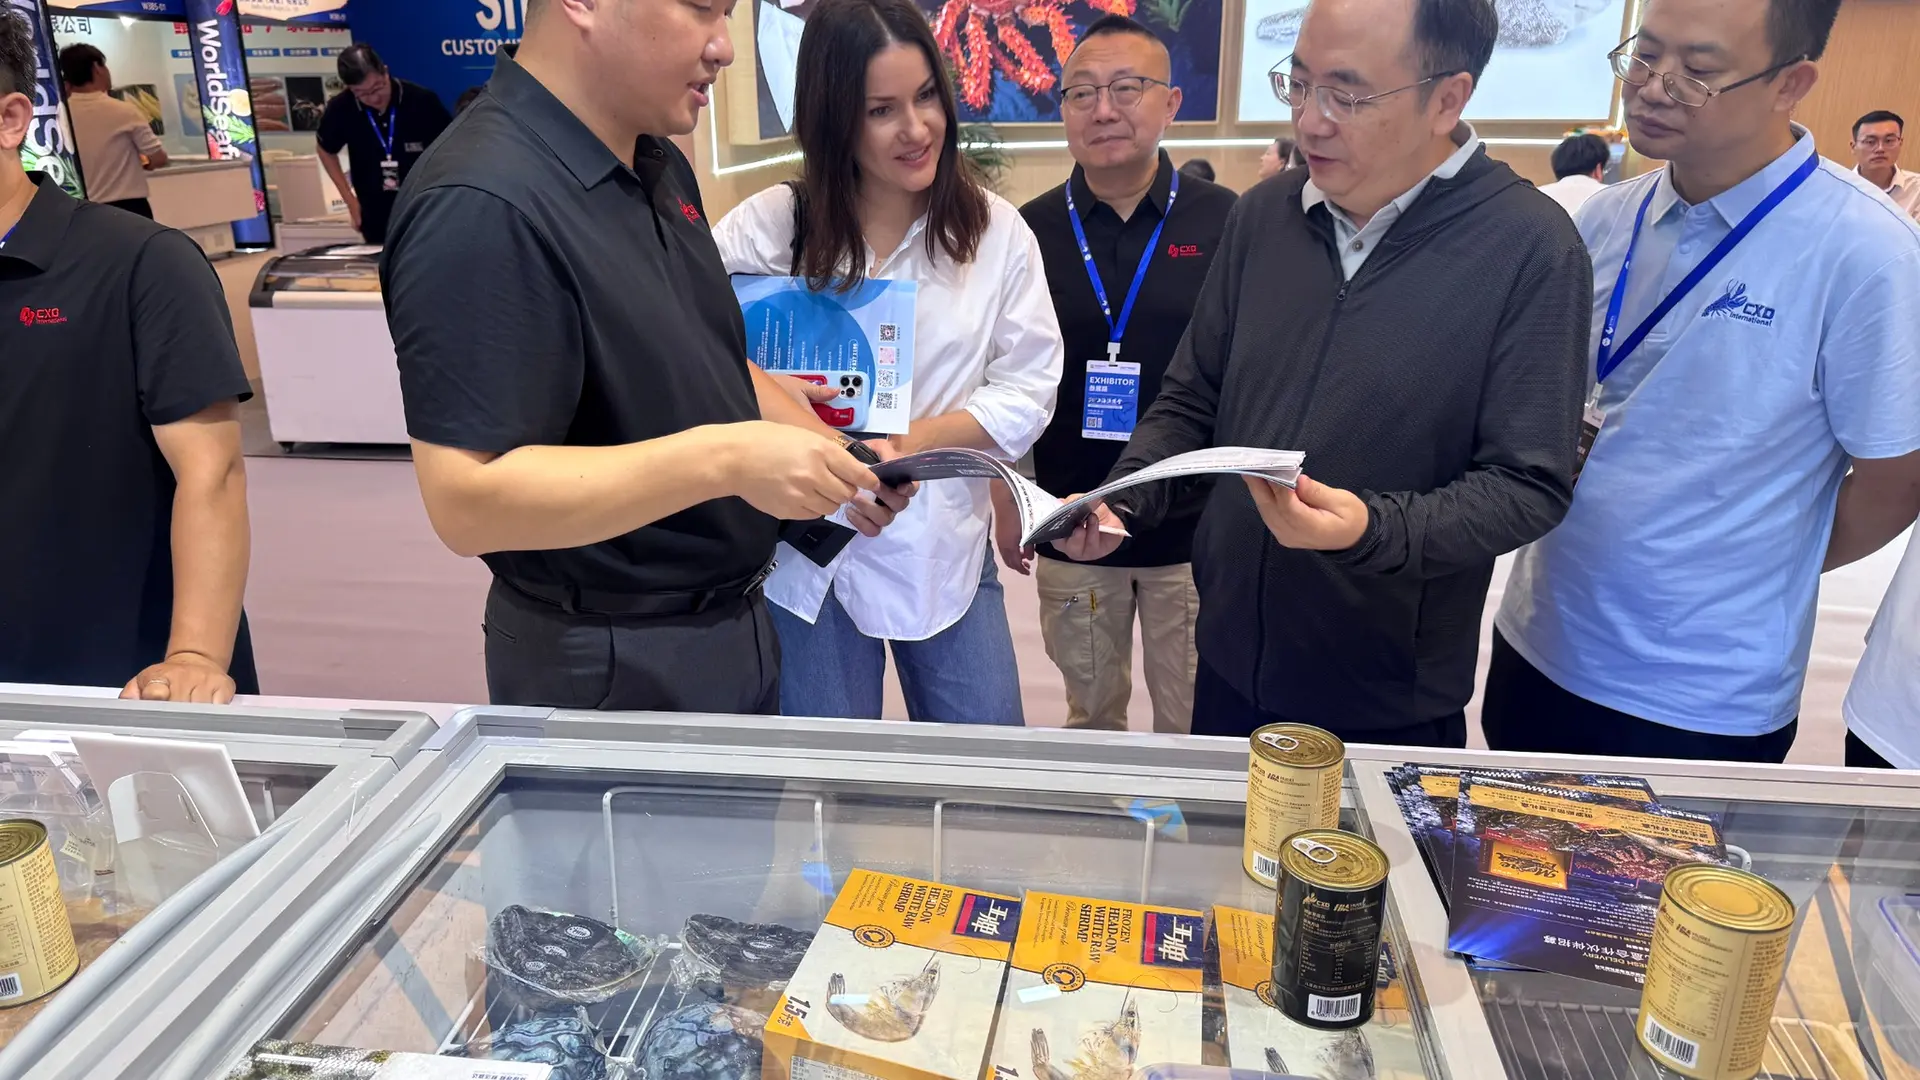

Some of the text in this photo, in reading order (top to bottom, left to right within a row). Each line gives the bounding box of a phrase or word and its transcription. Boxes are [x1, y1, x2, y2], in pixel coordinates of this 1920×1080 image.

[1729, 312, 1773, 327] International
[1089, 376, 1135, 386] EXHIBITOR
[894, 882, 914, 913] SHRIMP
[902, 885, 928, 930] WHITE RAW
[920, 887, 941, 924] HEAD-ON
[936, 889, 953, 917] FROZEN
[1077, 903, 1092, 943] SHRIMP
[1088, 906, 1106, 963] WHITE RAW
[1105, 907, 1120, 954] HEAD-ON
[1120, 908, 1132, 943] FROZEN
[1582, 952, 1625, 964] DELIVERY
